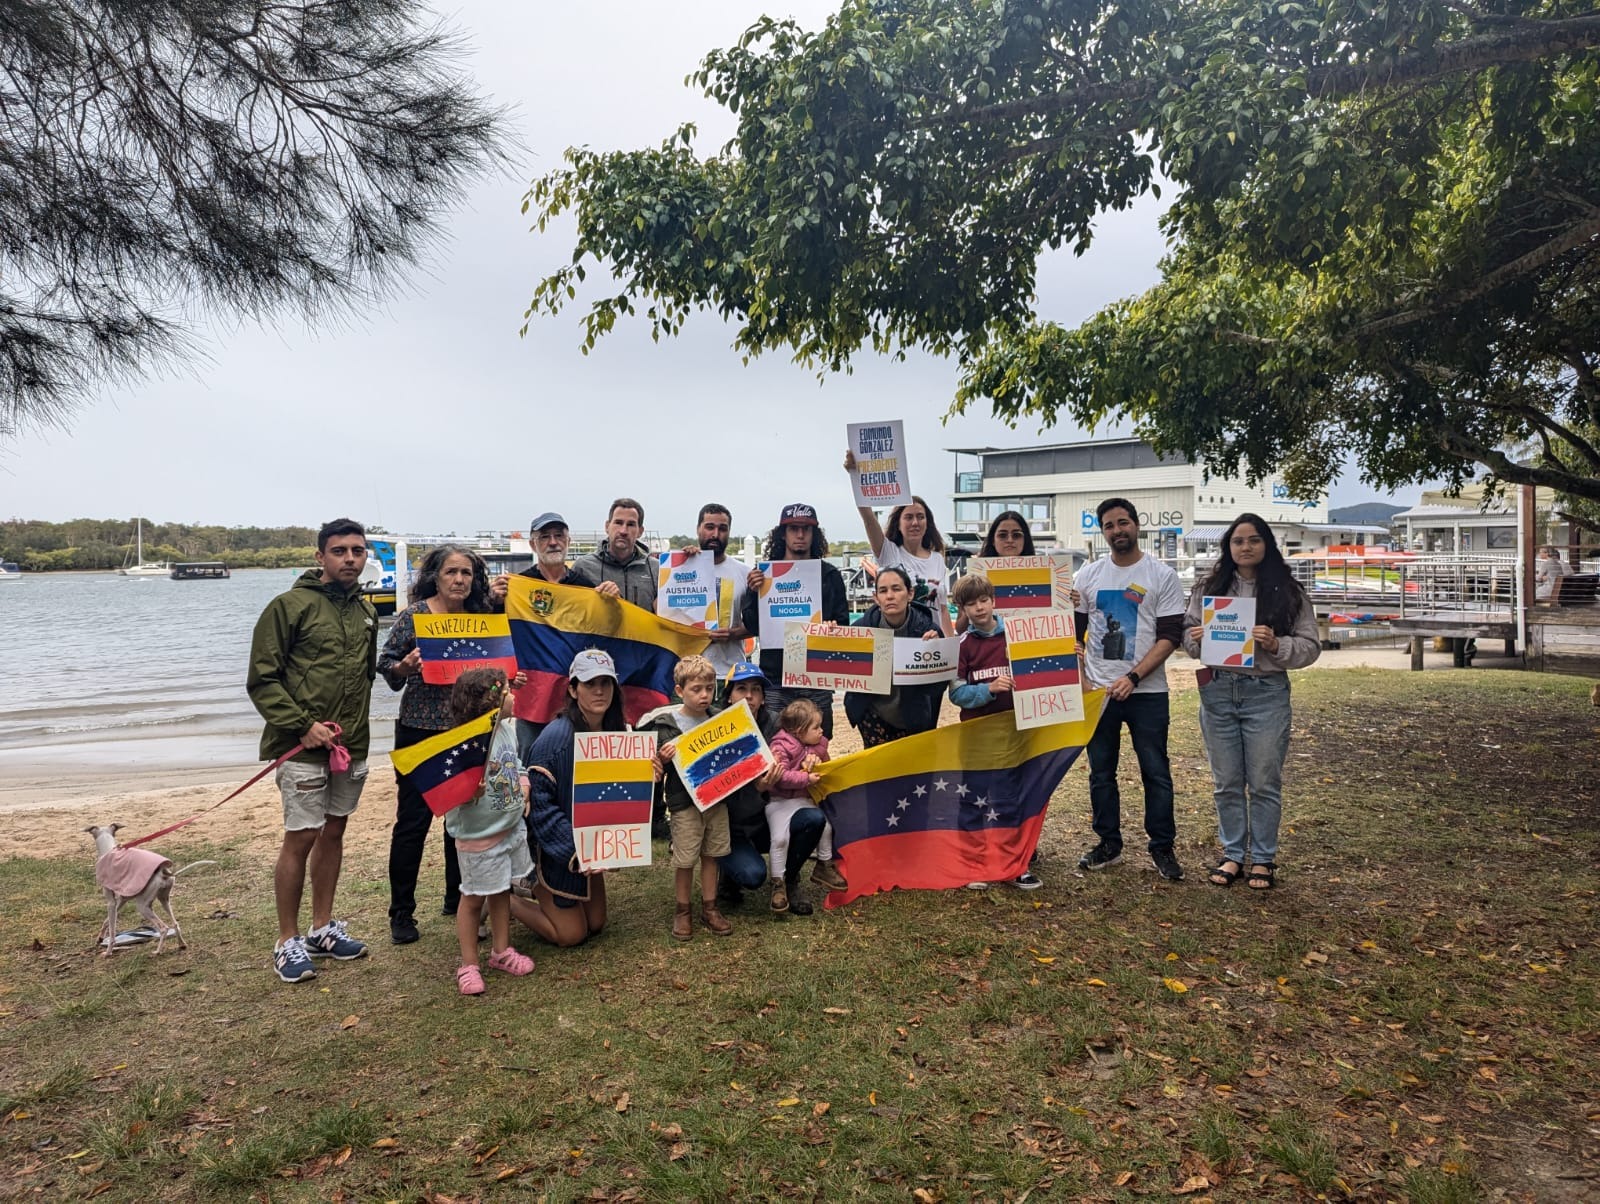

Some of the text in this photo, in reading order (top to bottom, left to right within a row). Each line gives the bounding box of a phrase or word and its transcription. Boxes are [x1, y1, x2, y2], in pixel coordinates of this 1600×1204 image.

[859, 426, 892, 441] EDMUNDO
[860, 470, 897, 486] ELECTO DE
[860, 483, 901, 497] VENEZUELA
[984, 556, 1056, 569] VENEZUELA
[666, 586, 708, 594] AUSTRALIA
[676, 597, 700, 605] NOOSA
[767, 595, 812, 605] AUSTRALIA
[778, 607, 803, 615] NOOSA
[424, 618, 490, 637] VENEZUELA
[801, 623, 874, 637] VENEZUELA
[1005, 614, 1076, 642] VENEZUELA
[1209, 624, 1247, 632] AUSTRALIA
[913, 650, 941, 662] SOS
[928, 661, 948, 669] KHAN
[784, 671, 872, 691] HASTA EL FINAL
[1021, 690, 1074, 721] LIBRE
[688, 722, 737, 754] VENEZUELA
[578, 734, 656, 759] VENEZUELA
[580, 827, 643, 863] LIBRE
